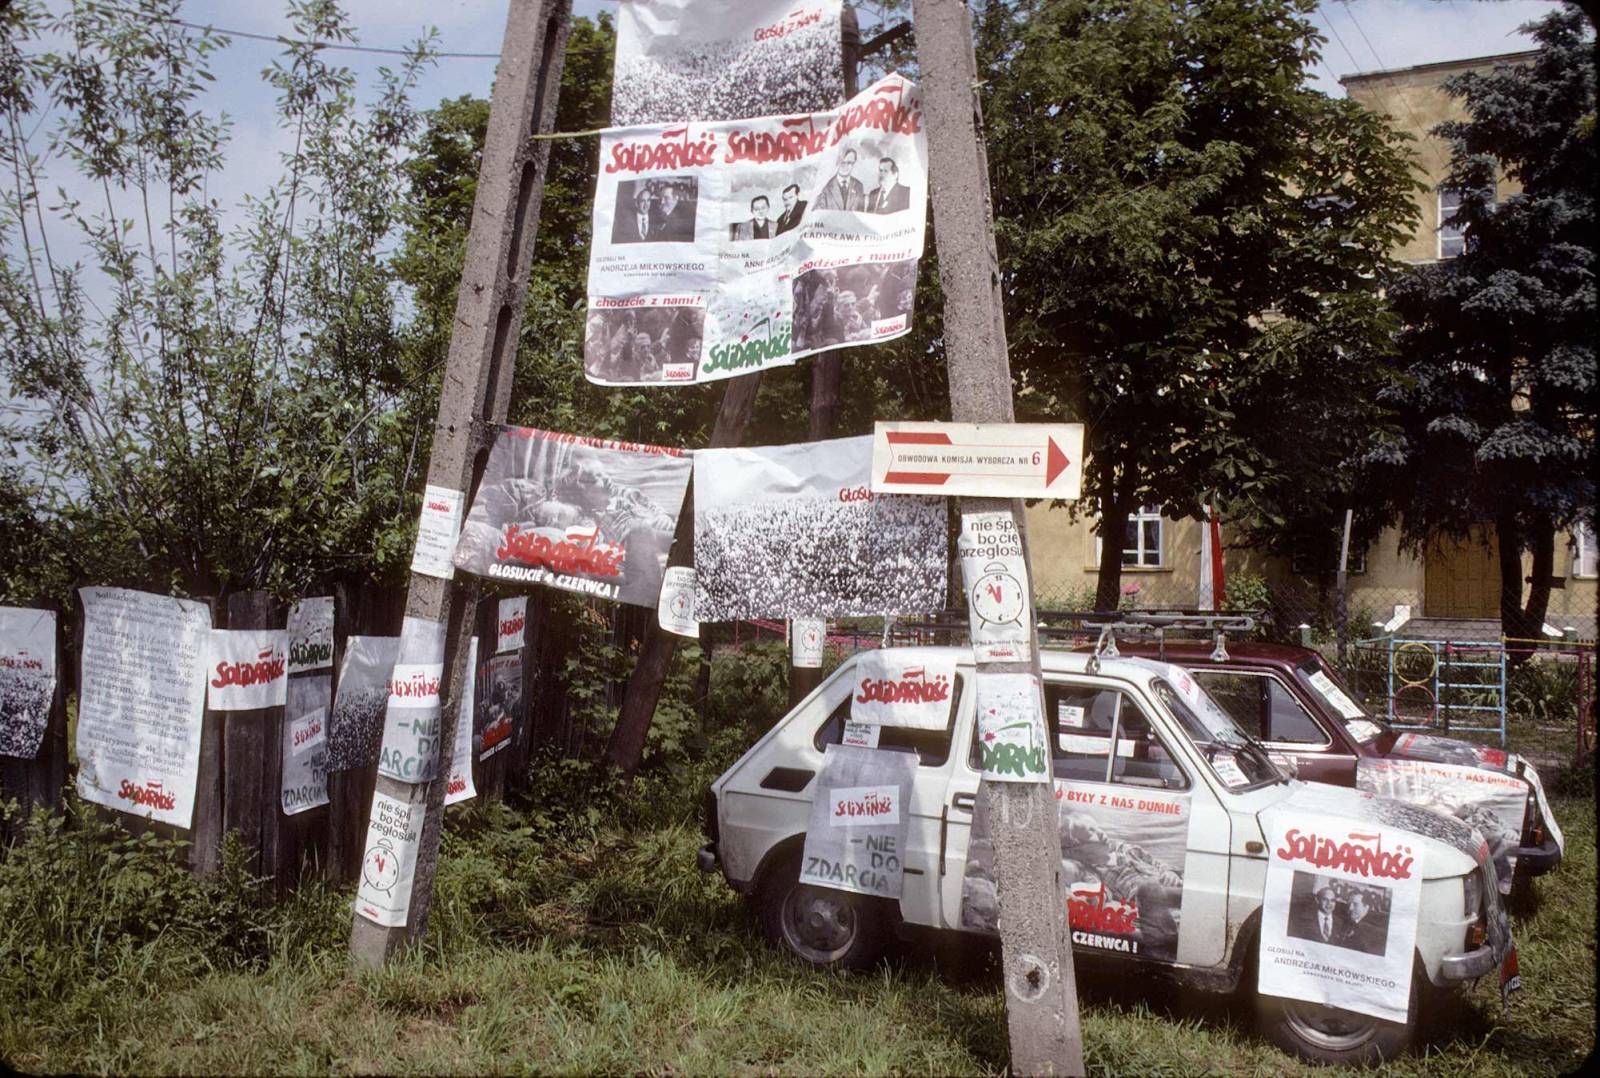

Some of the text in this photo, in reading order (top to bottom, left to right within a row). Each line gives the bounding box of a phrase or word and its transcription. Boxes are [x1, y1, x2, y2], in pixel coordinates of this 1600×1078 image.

[605, 126, 717, 174] SOLIDARNOŚĆ
[601, 263, 705, 273] ANDRZEJA MIŁKOWSKIEGO
[897, 451, 1041, 465] OBWODOWA KOMISJA WYBORCZA NR 6
[971, 521, 992, 531] nie
[978, 533, 1018, 546] bo cię
[488, 564, 543, 582] GŁOSUJCIE
[556, 574, 611, 597] CZERWCA
[211, 648, 285, 688] SOLIDARNOŚĆ
[857, 668, 949, 704] SOLIDARNOŚĆ
[413, 718, 439, 736] NIE
[418, 738, 439, 757] DO
[118, 779, 175, 810] SOLIDARNOŚĆ
[1067, 790, 1095, 803] BYŁY
[1100, 794, 1107, 805] Z
[1111, 796, 1134, 809] NAS
[1138, 801, 1182, 815] DUMNE
[377, 800, 392, 812] nie
[380, 811, 392, 824] bo
[866, 834, 896, 853] NIE
[871, 851, 899, 872] DO
[1277, 829, 1413, 880] SOLIDARNOŚĆ
[804, 856, 889, 892] ZDARCIA
[1072, 931, 1129, 953] CZERWCA
[1274, 957, 1320, 971] ANDRZEJA
[1321, 965, 1396, 989] MIŁKOWSKIEGO
